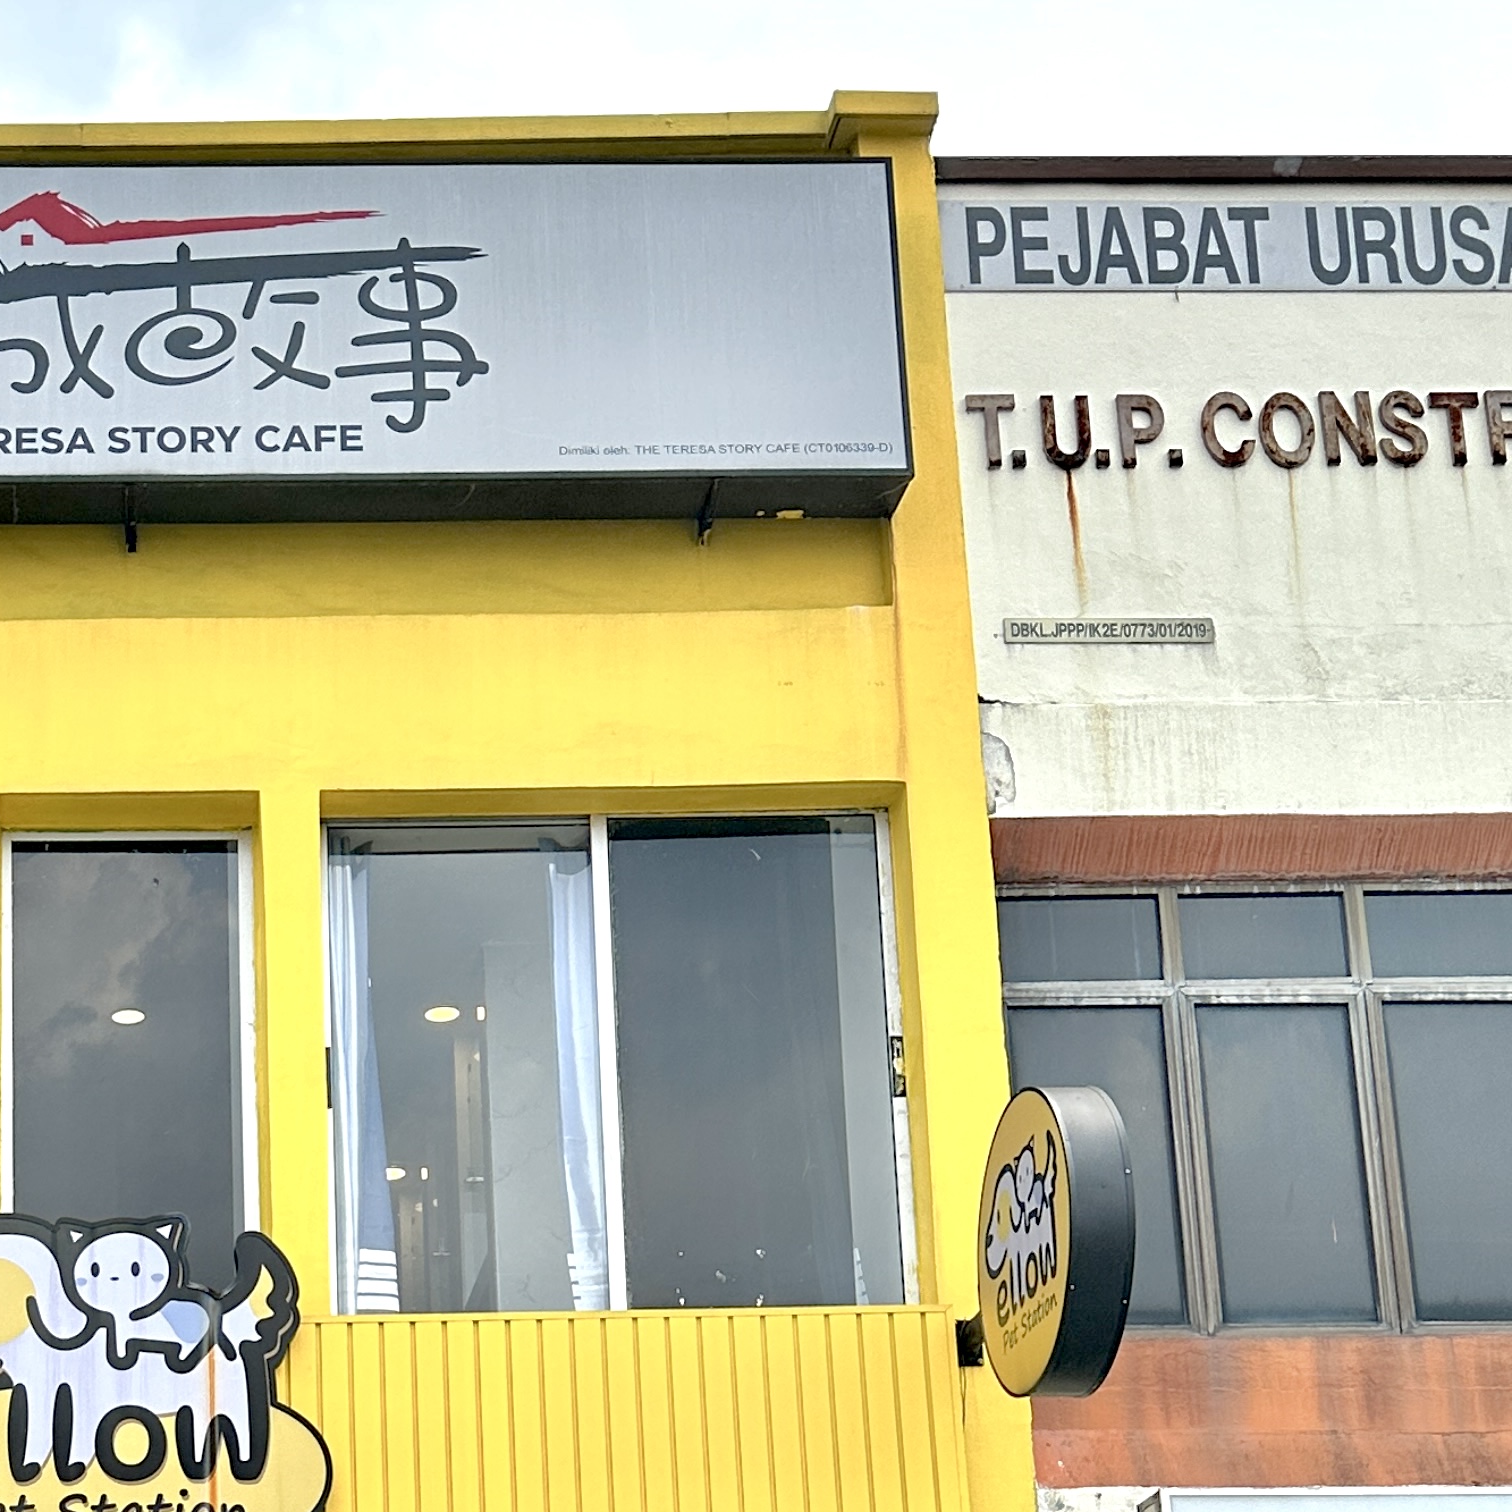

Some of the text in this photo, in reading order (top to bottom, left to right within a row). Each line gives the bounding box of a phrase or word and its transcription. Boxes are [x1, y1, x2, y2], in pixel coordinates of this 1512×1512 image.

[964, 206, 1270, 285] PEJABAT
[107, 425, 241, 454] STORY
[254, 424, 364, 452] CAFE
[558, 445, 599, 456] Dimiliki
[634, 444, 661, 455] THE
[664, 444, 716, 455] TERESA
[718, 443, 762, 455] STORY
[766, 443, 800, 454] CAFE
[997, 1241, 1057, 1328] ellow
[1002, 1292, 1057, 1356] Pet Station
